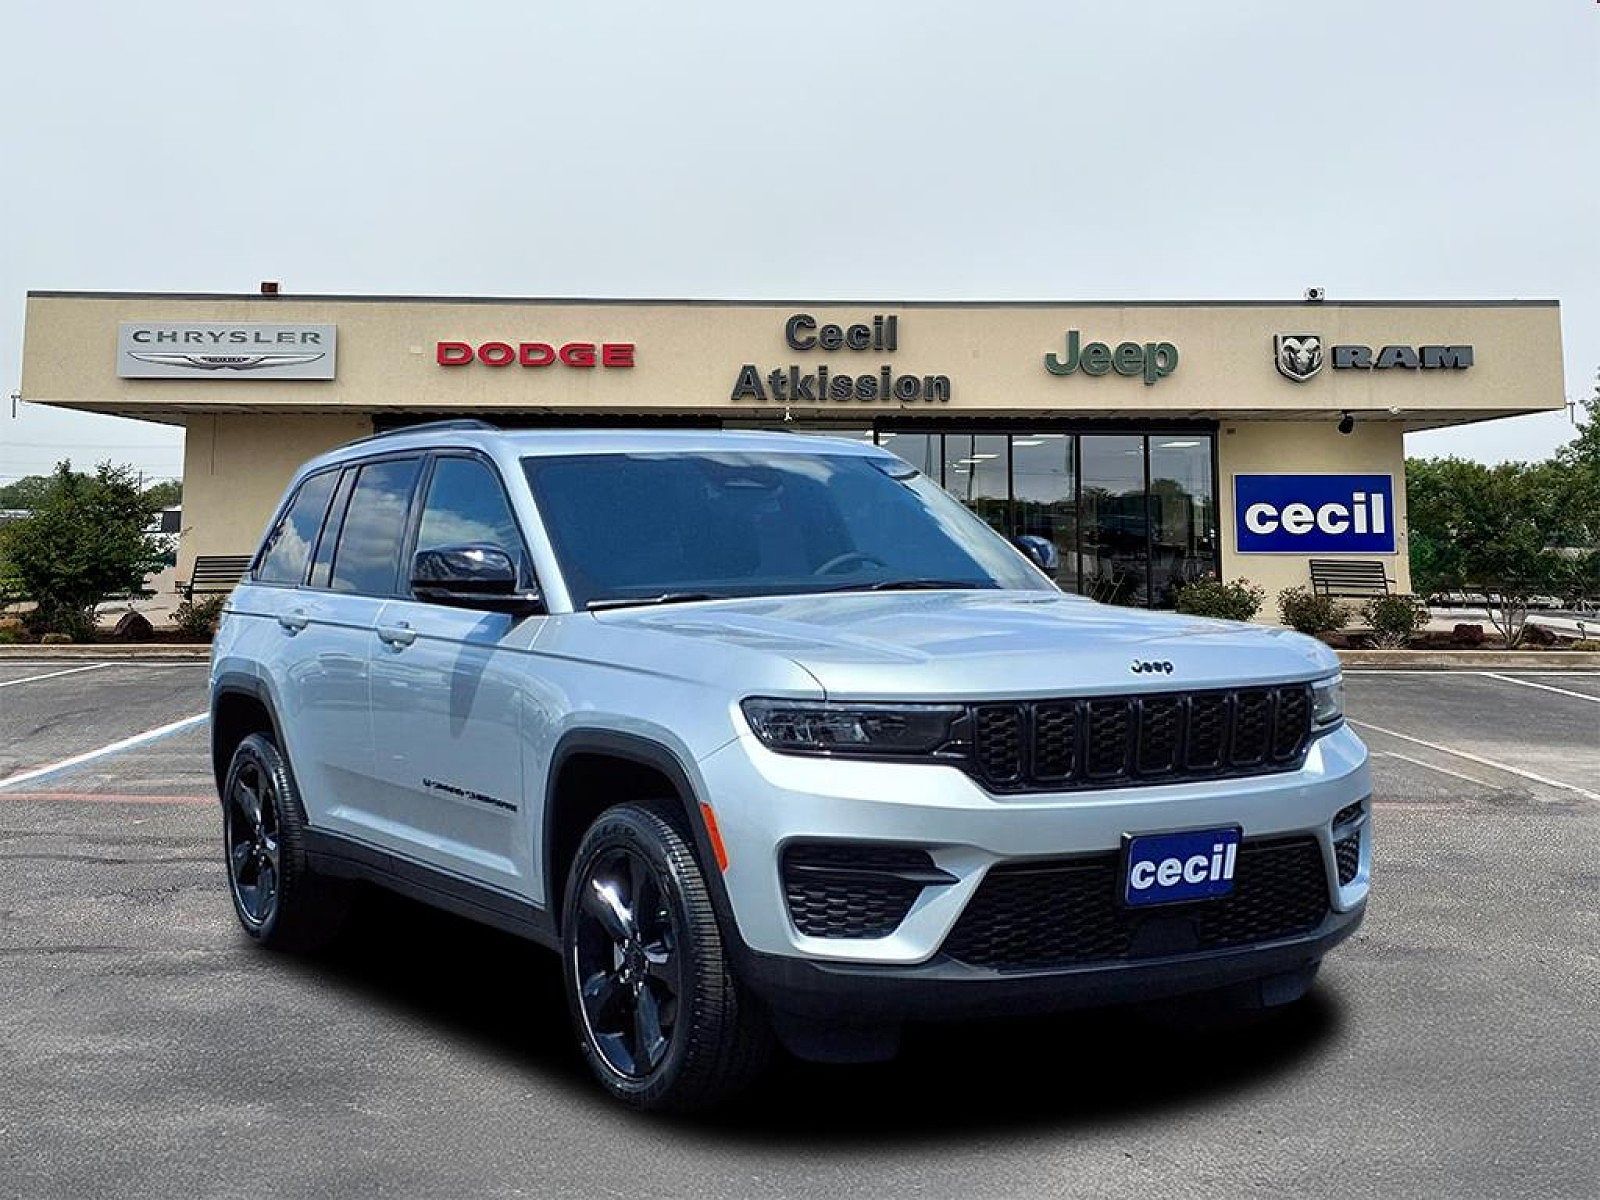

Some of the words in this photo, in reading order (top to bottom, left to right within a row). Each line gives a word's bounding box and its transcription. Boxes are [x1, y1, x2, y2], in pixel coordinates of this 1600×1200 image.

[132, 330, 321, 344] CHRYSLER
[785, 313, 897, 350] Cecil
[437, 342, 635, 367] DODGE
[1045, 330, 1179, 386] Jeep
[1332, 345, 1474, 369] RAM
[731, 365, 951, 401] Atkission
[1245, 491, 1385, 534] cecil
[1131, 659, 1173, 675] Jeep
[1131, 843, 1237, 890] cecil
